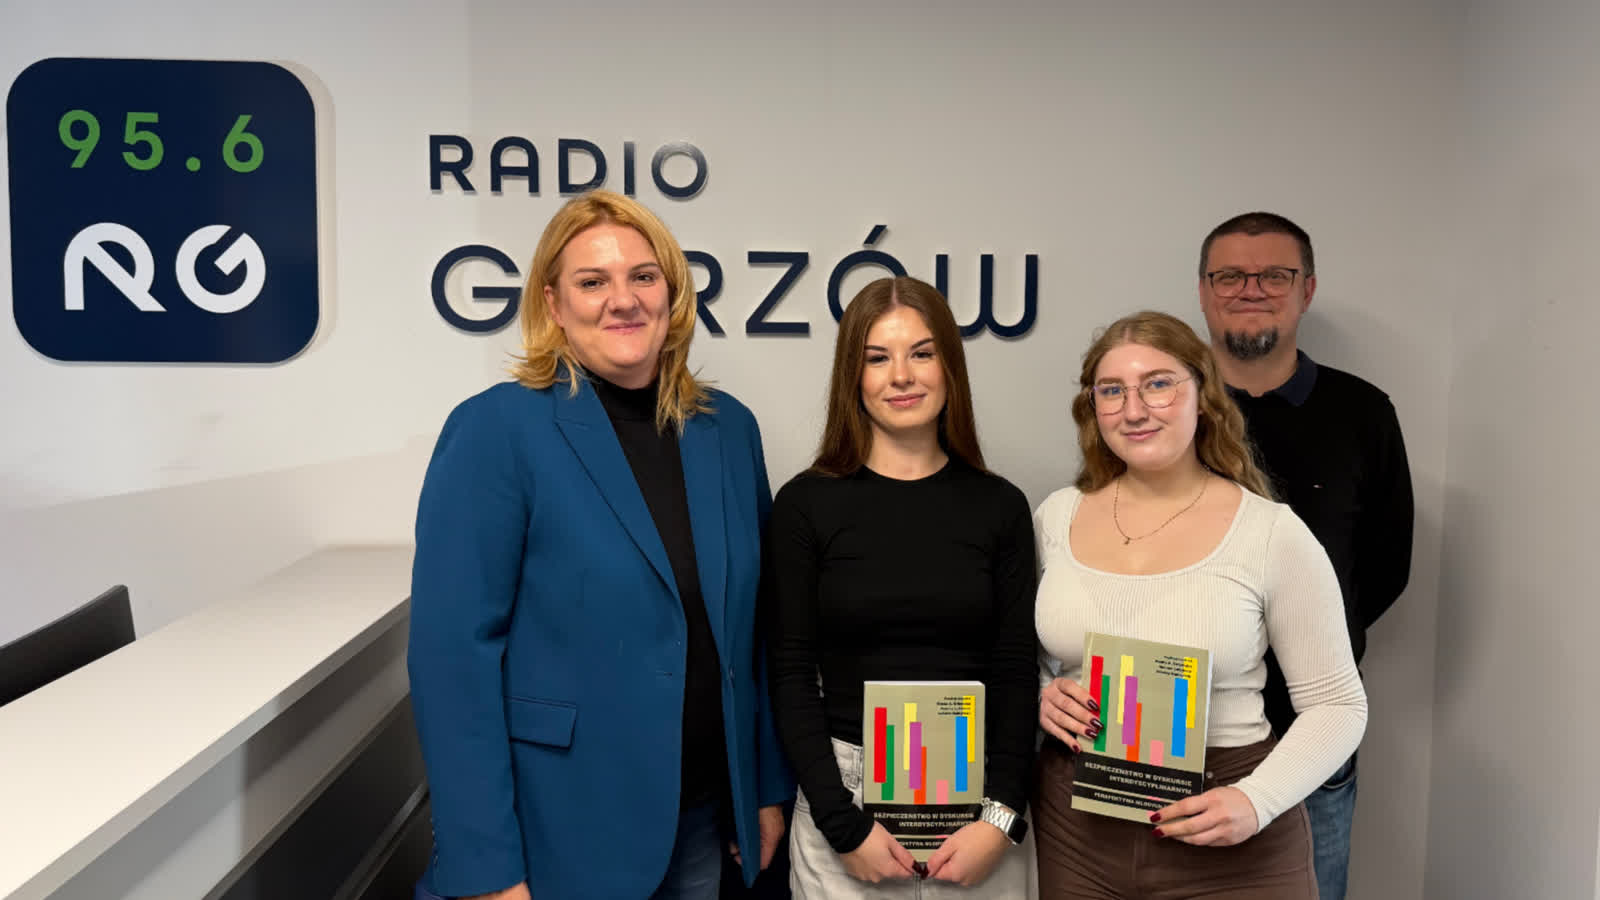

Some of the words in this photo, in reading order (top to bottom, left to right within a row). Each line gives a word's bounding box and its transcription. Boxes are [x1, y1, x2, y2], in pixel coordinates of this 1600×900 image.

[58, 109, 264, 172] 95.6
[429, 134, 708, 199] RADIO
[63, 222, 266, 313] RG
[430, 224, 1039, 339] GRZÓW
